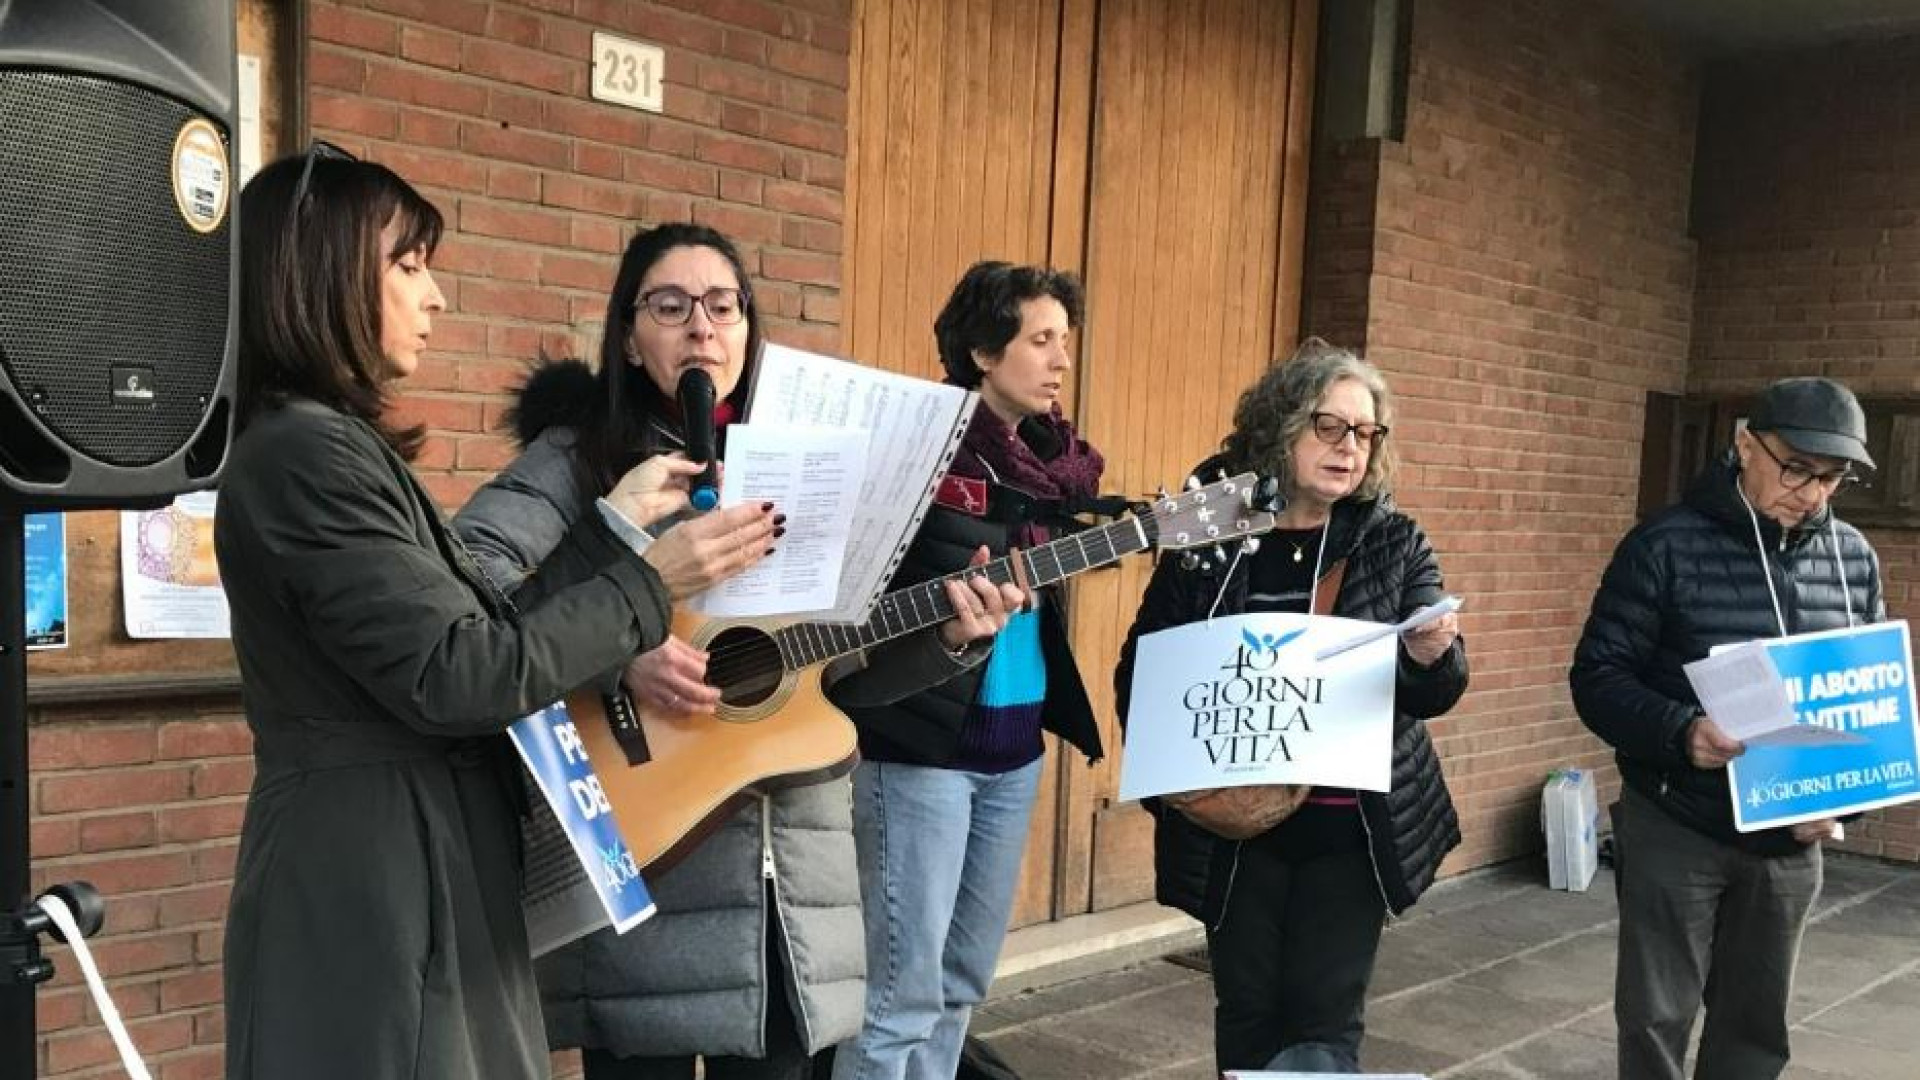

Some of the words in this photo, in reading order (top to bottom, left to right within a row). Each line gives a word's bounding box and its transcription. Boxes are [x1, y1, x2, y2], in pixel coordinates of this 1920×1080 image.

[603, 48, 651, 97] 231
[1220, 644, 1278, 678] 40
[1183, 676, 1325, 711] GIORNI
[1809, 661, 1904, 701] ABORTO
[1191, 706, 1258, 739] PER
[1267, 705, 1313, 733] LA
[1804, 696, 1900, 731] VITTIME
[1204, 734, 1294, 766] VITA
[1771, 774, 1833, 801] GIORNI
[1836, 770, 1863, 791] PER
[1864, 767, 1882, 785] LA
[1880, 760, 1914, 781] VITA
